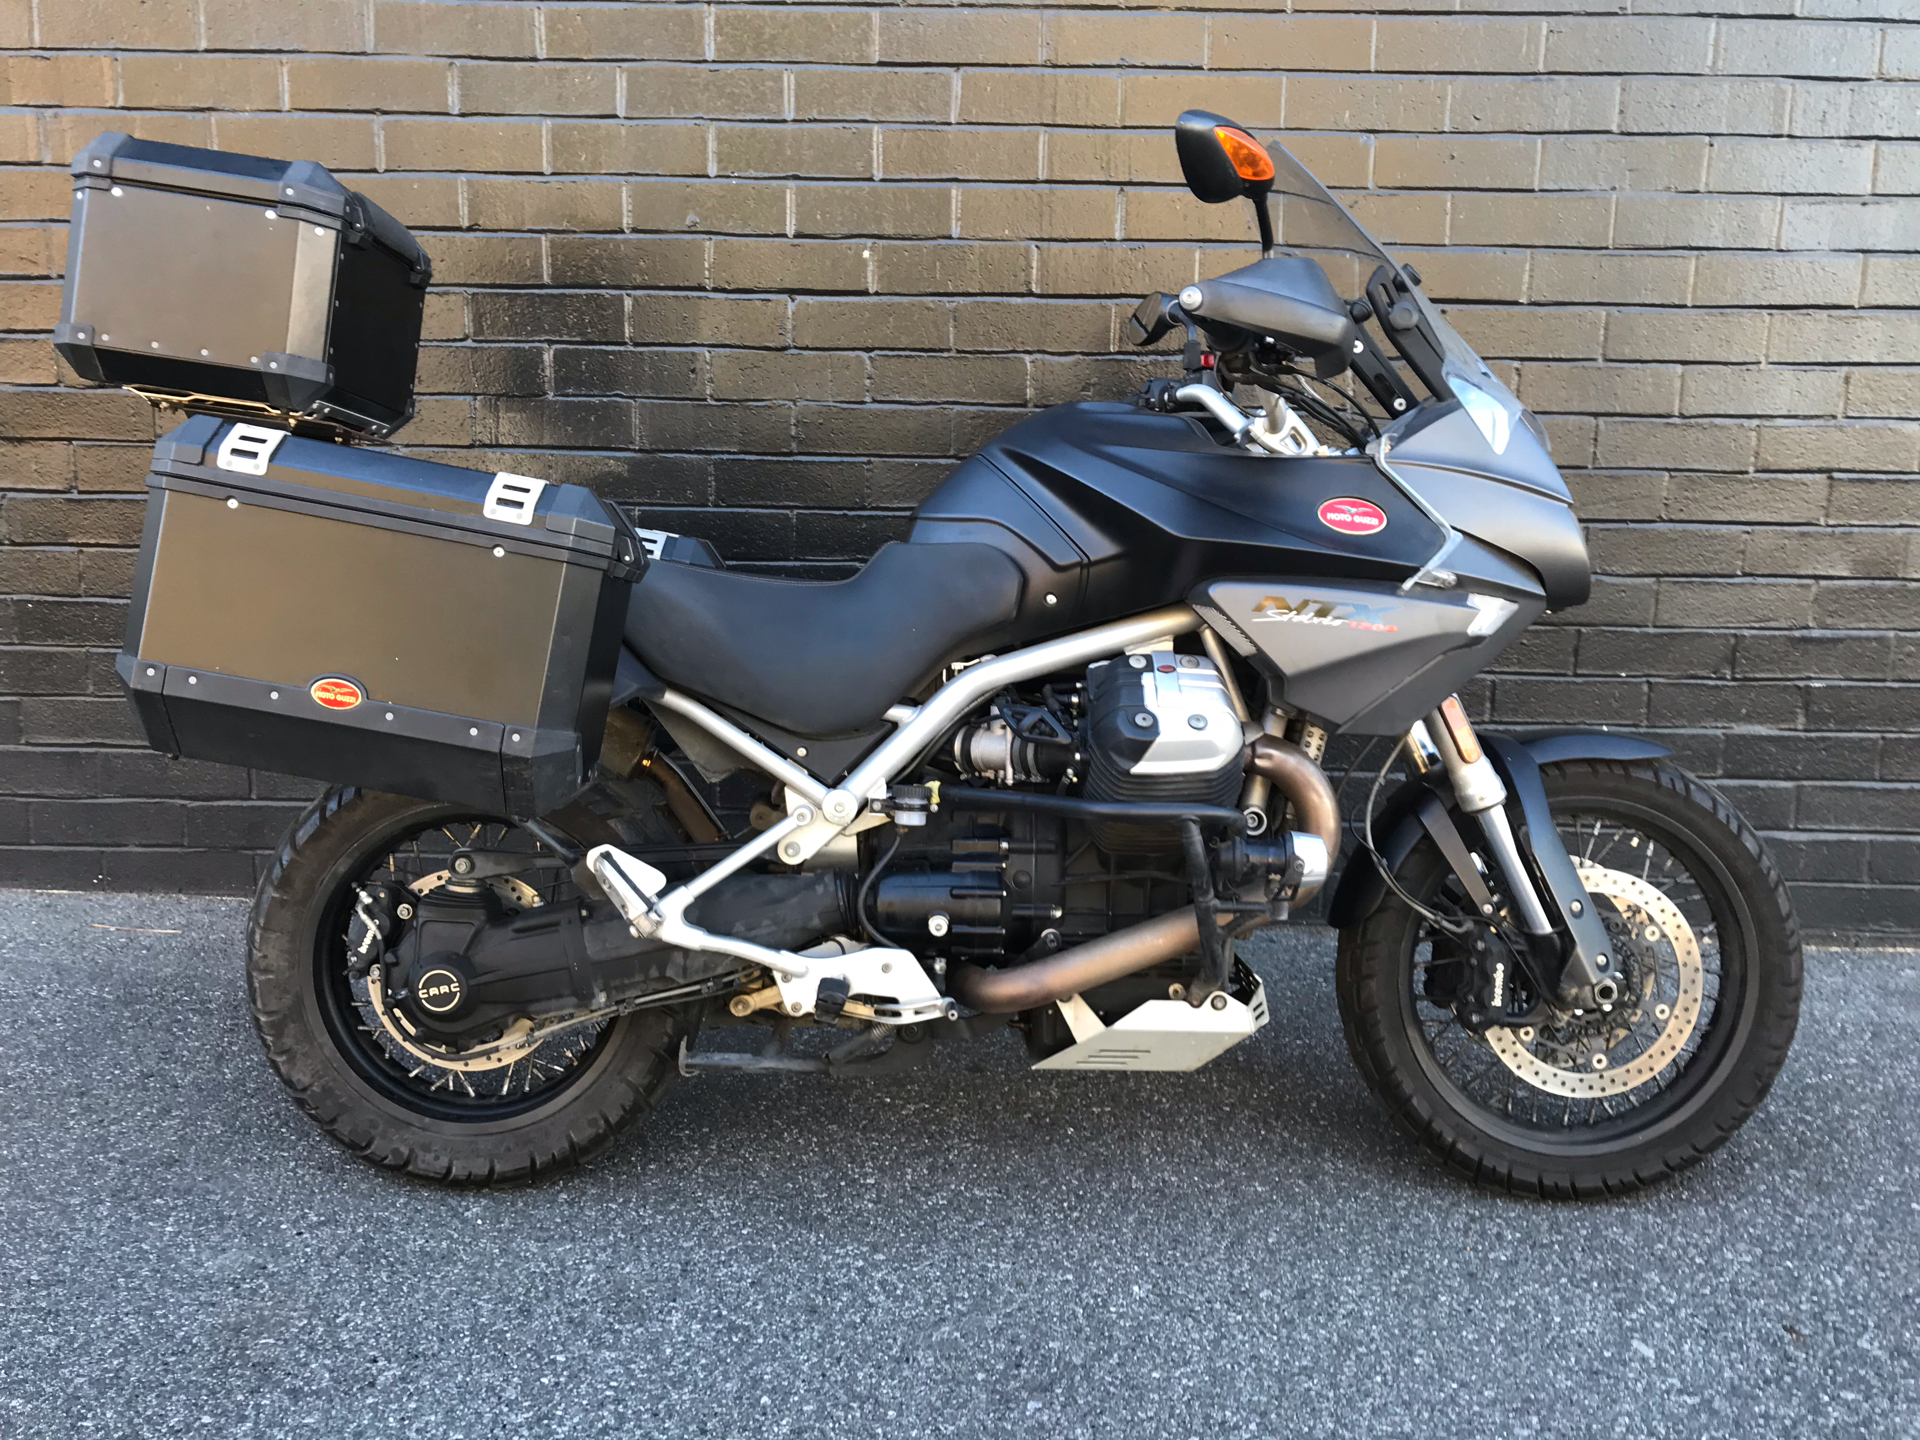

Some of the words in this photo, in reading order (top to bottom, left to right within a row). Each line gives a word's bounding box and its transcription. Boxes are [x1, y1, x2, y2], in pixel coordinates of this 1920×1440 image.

[1326, 512, 1352, 522] MOTO
[1353, 515, 1379, 526] GUZZI
[315, 690, 335, 700] MOTO
[336, 694, 356, 703] GUZZI
[418, 982, 460, 998] CARC
[1491, 962, 1505, 1007] brembo
